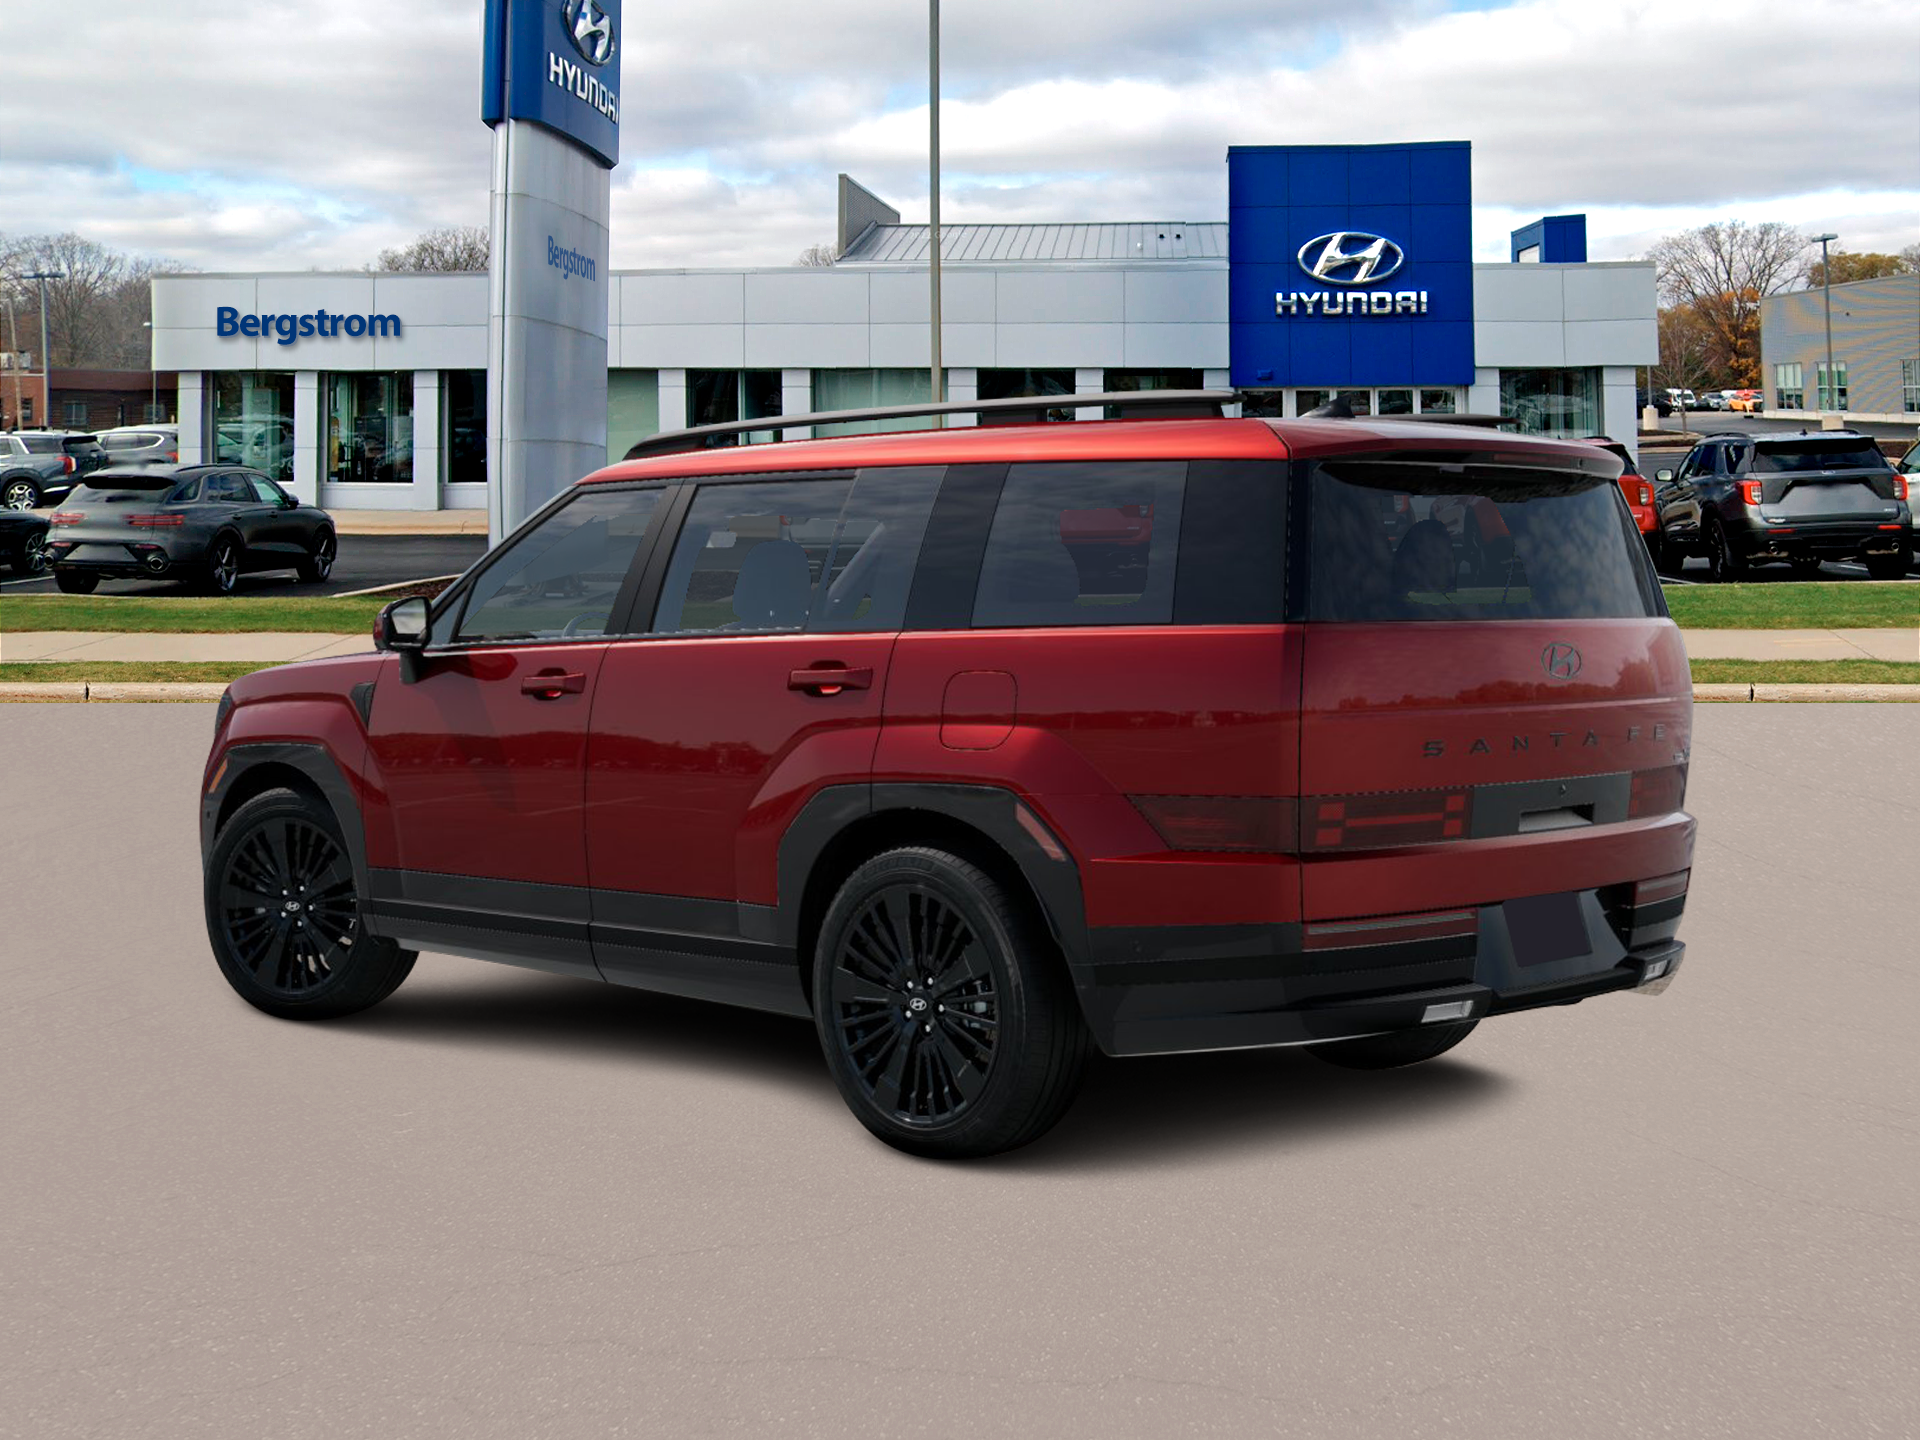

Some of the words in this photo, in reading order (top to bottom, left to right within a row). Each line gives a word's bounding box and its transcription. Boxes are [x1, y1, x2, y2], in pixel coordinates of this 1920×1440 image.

[549, 52, 618, 124] HYUNDAI
[547, 235, 596, 281] Bergstrom
[1276, 291, 1428, 315] HYUNDAI
[217, 306, 401, 346] Bergstrom
[1422, 730, 1599, 757] SANTA
[1627, 723, 1667, 743] FE
